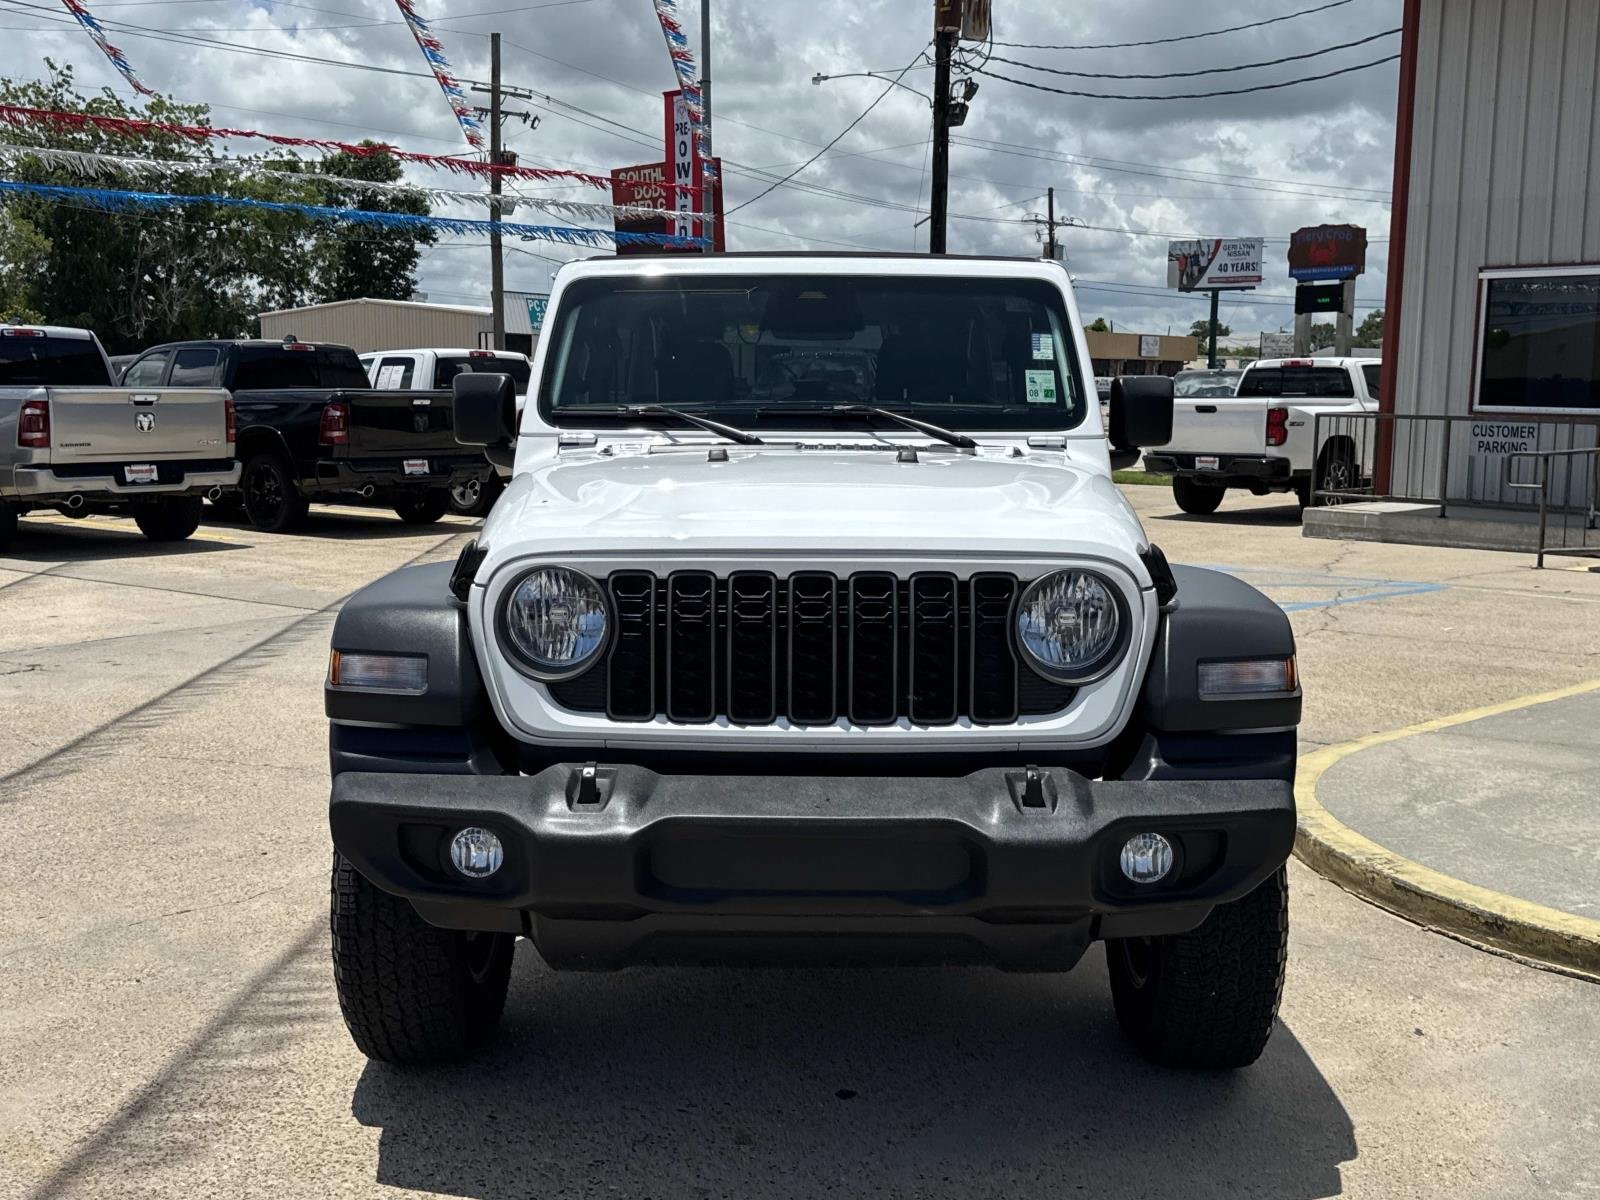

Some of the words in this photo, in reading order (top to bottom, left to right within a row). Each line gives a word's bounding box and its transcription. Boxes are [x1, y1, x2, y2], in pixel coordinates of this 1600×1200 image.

[1217, 263, 1229, 273] 40
[1230, 261, 1259, 273] YEARS!
[1029, 389, 1039, 397] 08
[1472, 424, 1535, 439] CUSTOMER
[1478, 441, 1528, 453] PARKING
